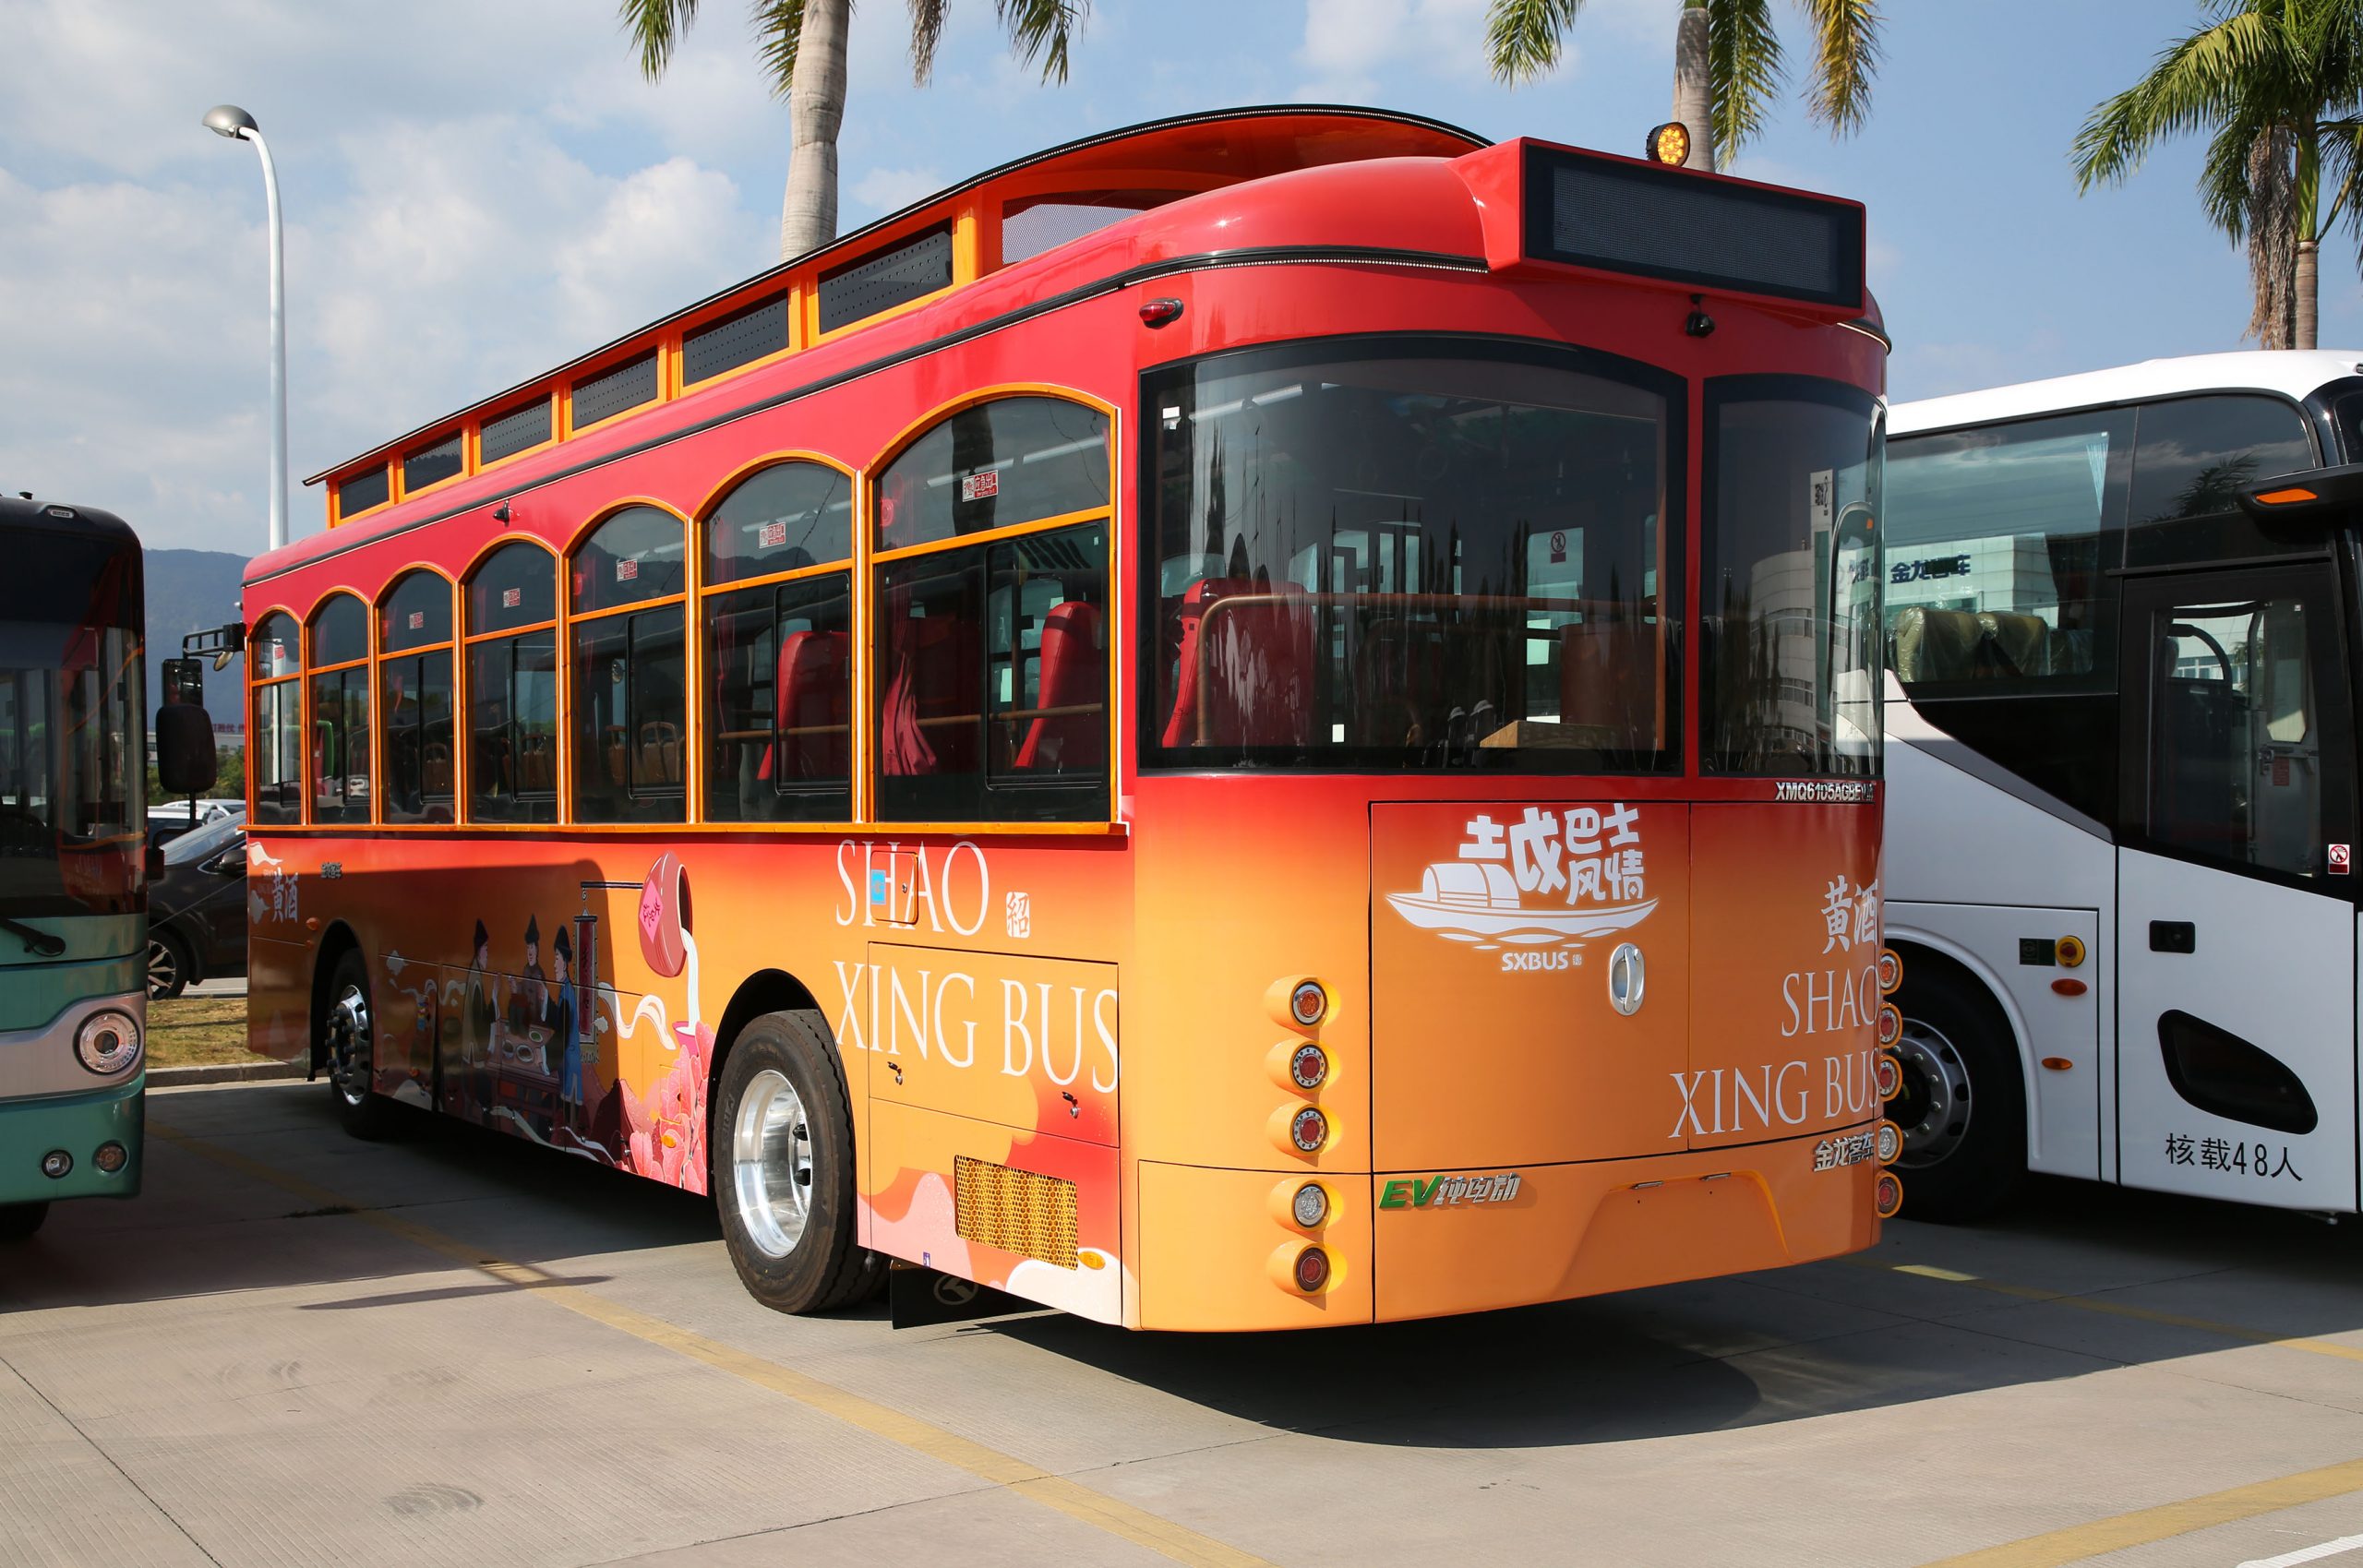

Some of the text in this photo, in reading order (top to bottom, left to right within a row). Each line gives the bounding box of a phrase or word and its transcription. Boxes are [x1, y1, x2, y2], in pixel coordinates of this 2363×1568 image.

[1890, 555, 1971, 583] 金龙车
[1565, 803, 1639, 855] 巴士
[835, 839, 990, 936] SHAO
[1566, 849, 1644, 904] 风情
[1820, 875, 1878, 954] 黄酒
[1501, 952, 1569, 972] SXBUS
[833, 961, 1122, 1094] XING BUS
[1781, 965, 1880, 1037] SHAO
[1668, 1047, 1880, 1138] XING BUS
[1813, 1131, 1875, 1172] 金龙客车
[2165, 1132, 2303, 1182] 核载48人
